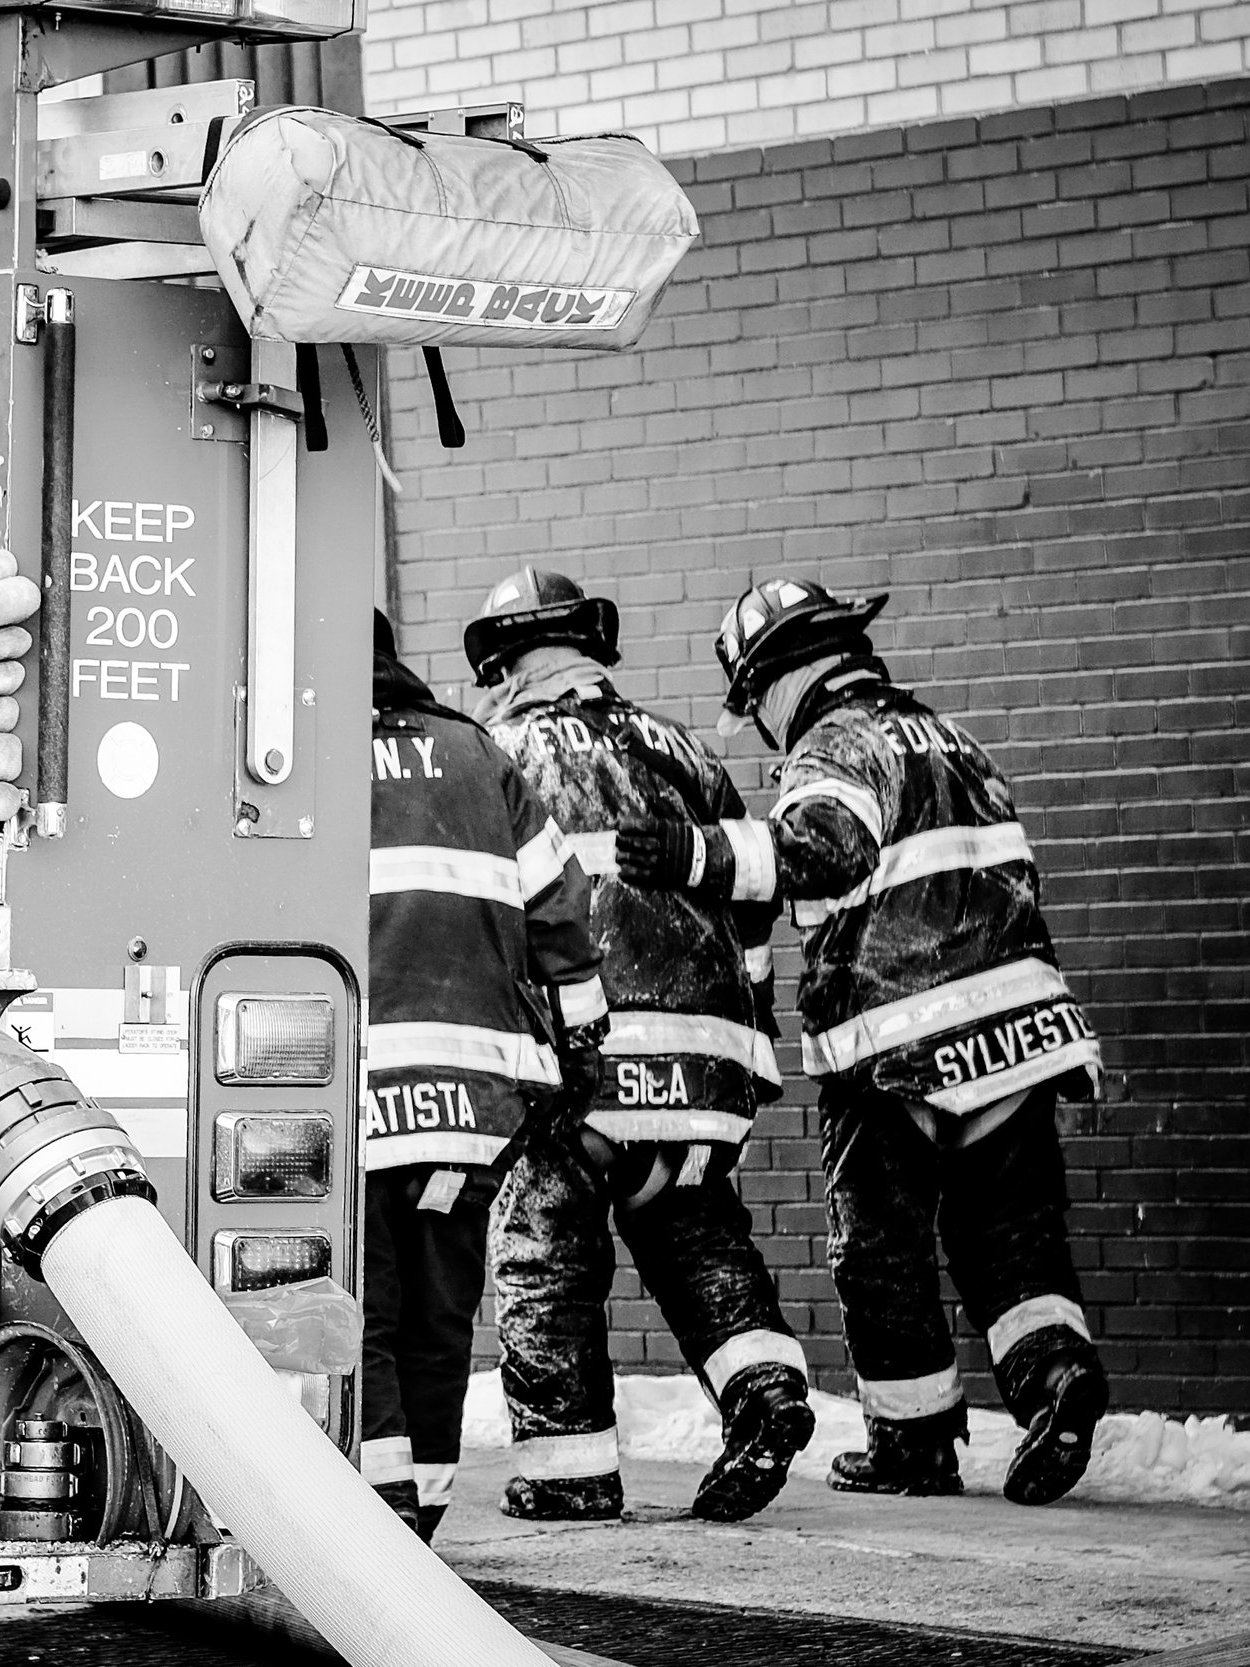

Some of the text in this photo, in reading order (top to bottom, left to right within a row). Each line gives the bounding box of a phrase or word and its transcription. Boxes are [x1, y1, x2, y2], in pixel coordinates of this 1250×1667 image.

[353, 268, 607, 325] KEEP BACK
[71, 498, 196, 543] KEEP
[70, 551, 197, 597] BACK
[85, 605, 180, 650] 200
[72, 658, 191, 702] FEET
